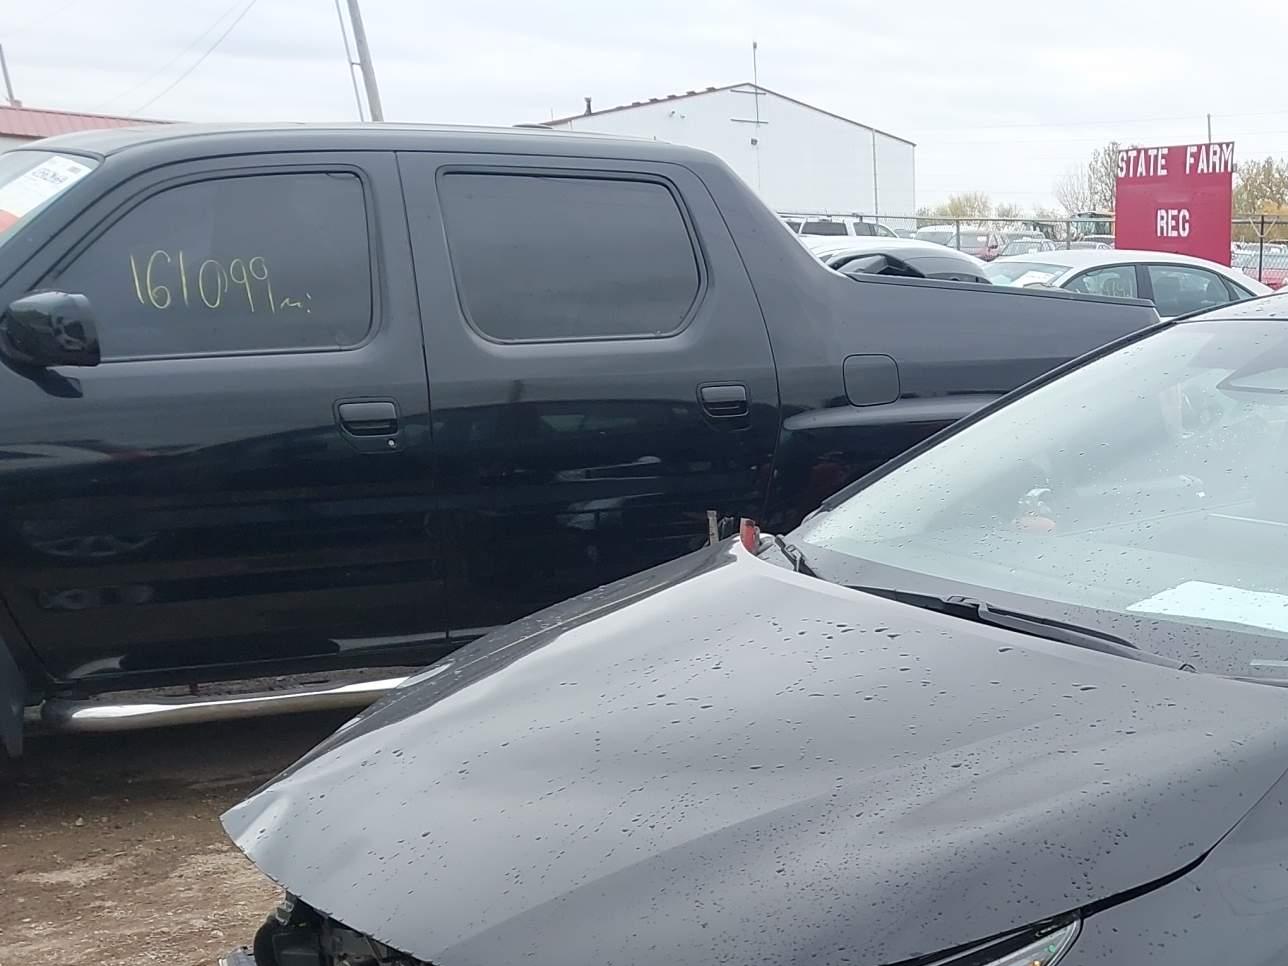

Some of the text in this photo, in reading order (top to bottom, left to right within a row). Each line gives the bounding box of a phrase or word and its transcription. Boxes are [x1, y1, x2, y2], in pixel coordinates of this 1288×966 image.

[1117, 143, 1233, 178] STATE FARM
[130, 250, 275, 313] 161099
